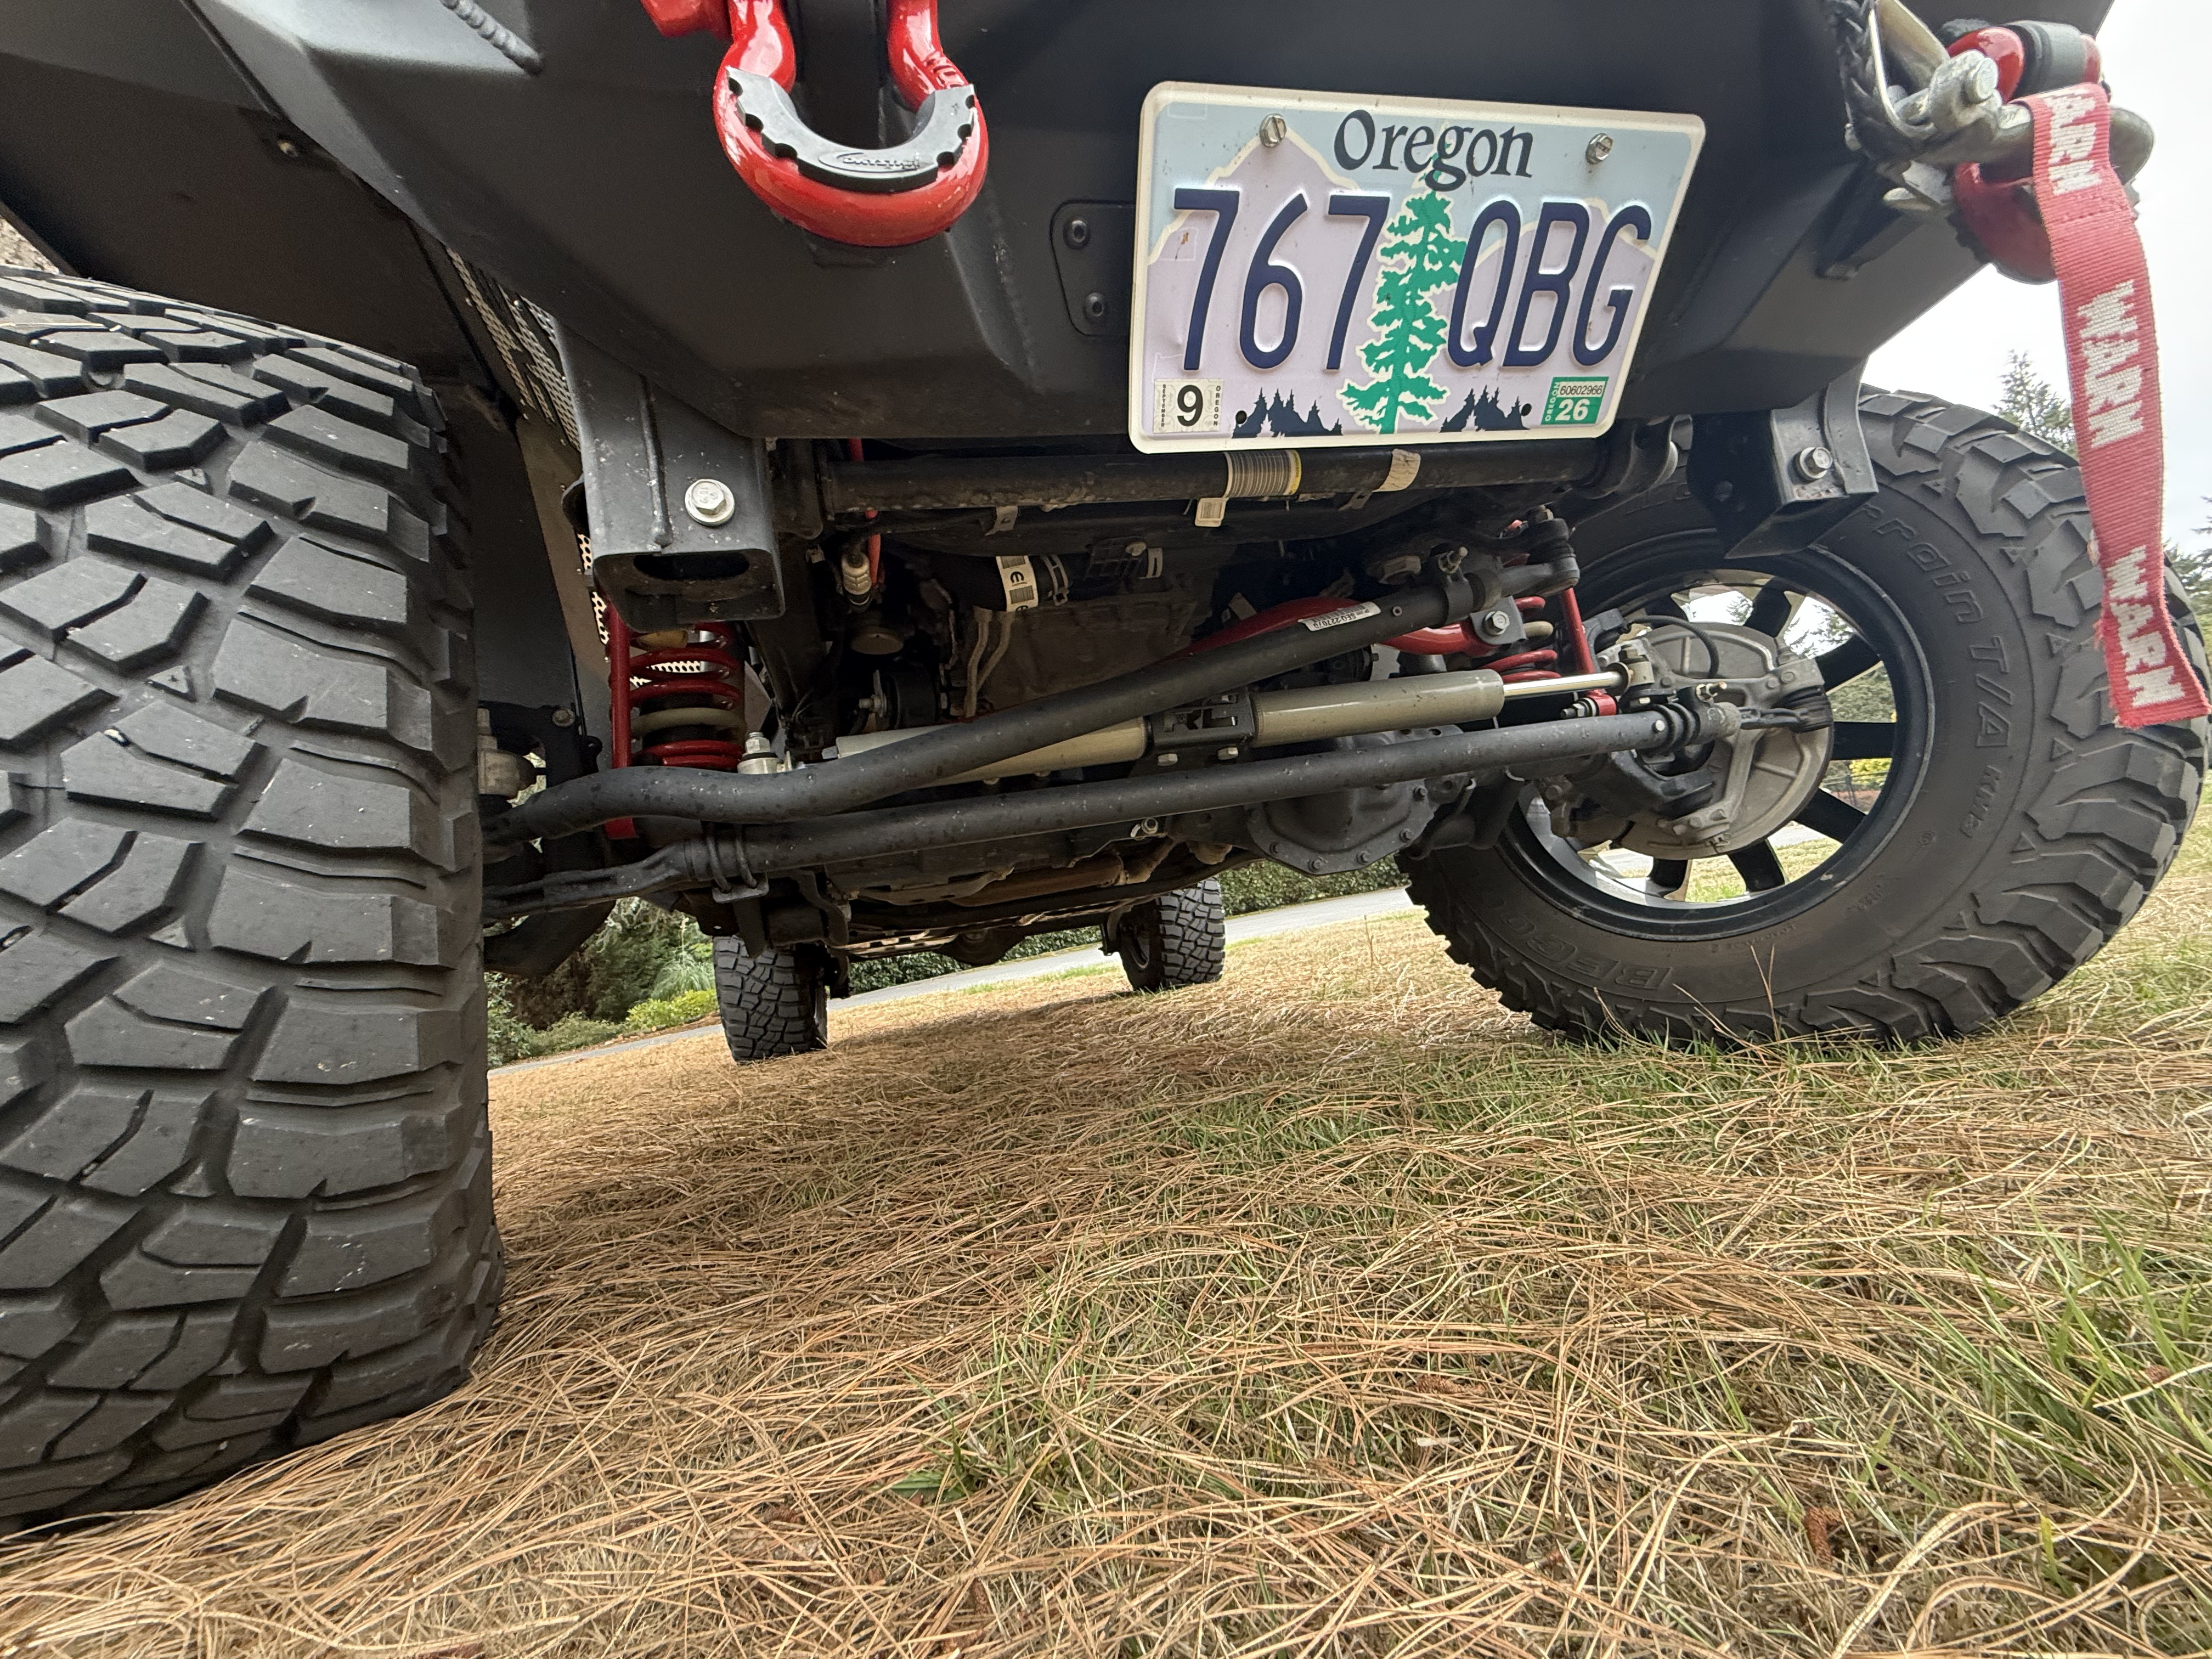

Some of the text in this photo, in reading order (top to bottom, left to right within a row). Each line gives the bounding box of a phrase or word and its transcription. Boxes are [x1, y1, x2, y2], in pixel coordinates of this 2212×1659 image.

[1333, 109, 1533, 192] Oregon
[2042, 88, 2103, 196] ARN
[1173, 188, 1654, 372] 767 QBG
[1560, 385, 1603, 395] 60602966
[2077, 279, 2144, 448] WARN
[1176, 384, 1204, 427] 9
[1213, 385, 1221, 426] OREGON
[1544, 382, 1560, 422] OREGON
[1555, 399, 1590, 421] 26
[1341, 613, 1357, 622] SEQ
[2106, 545, 2186, 707] WARN
[1968, 635, 2013, 747] T/A
